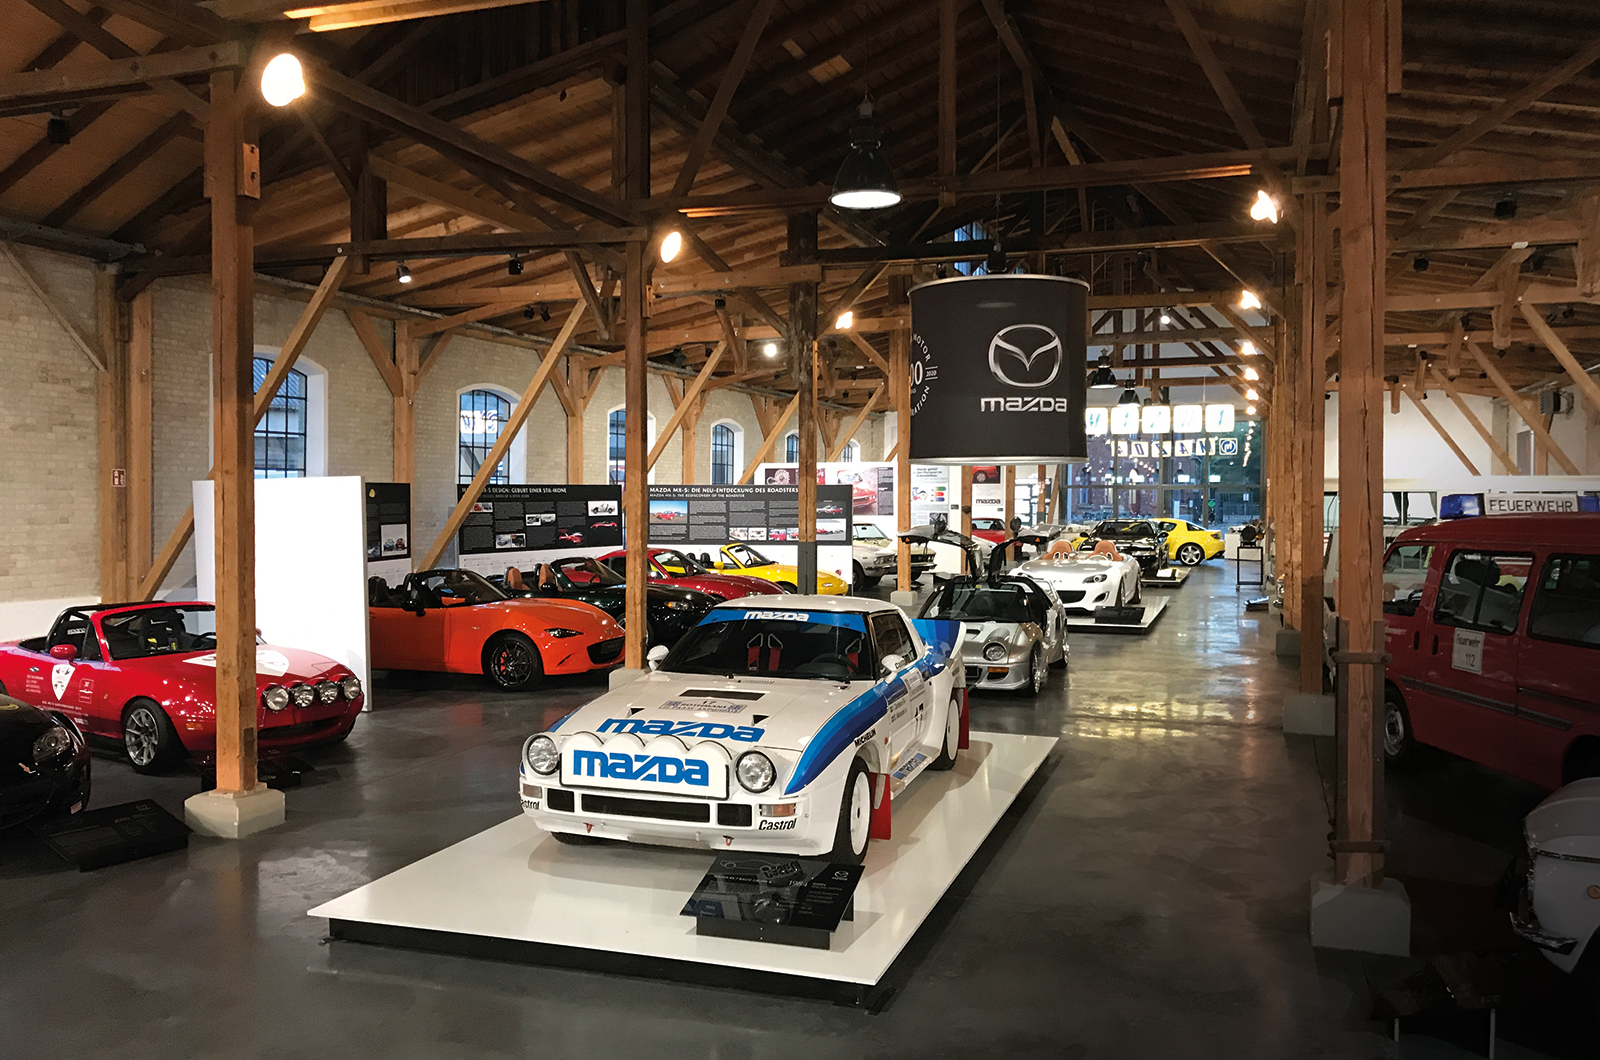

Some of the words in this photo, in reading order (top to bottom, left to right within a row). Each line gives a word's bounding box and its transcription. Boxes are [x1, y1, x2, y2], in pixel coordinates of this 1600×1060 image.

[1490, 500, 1572, 512] FEUERWEHR
[1456, 634, 1480, 648] Feuerwehr
[1465, 653, 1476, 667] 112
[854, 728, 876, 747] MICHELIN
[520, 800, 540, 810] astrol
[758, 818, 797, 831] Castrol
